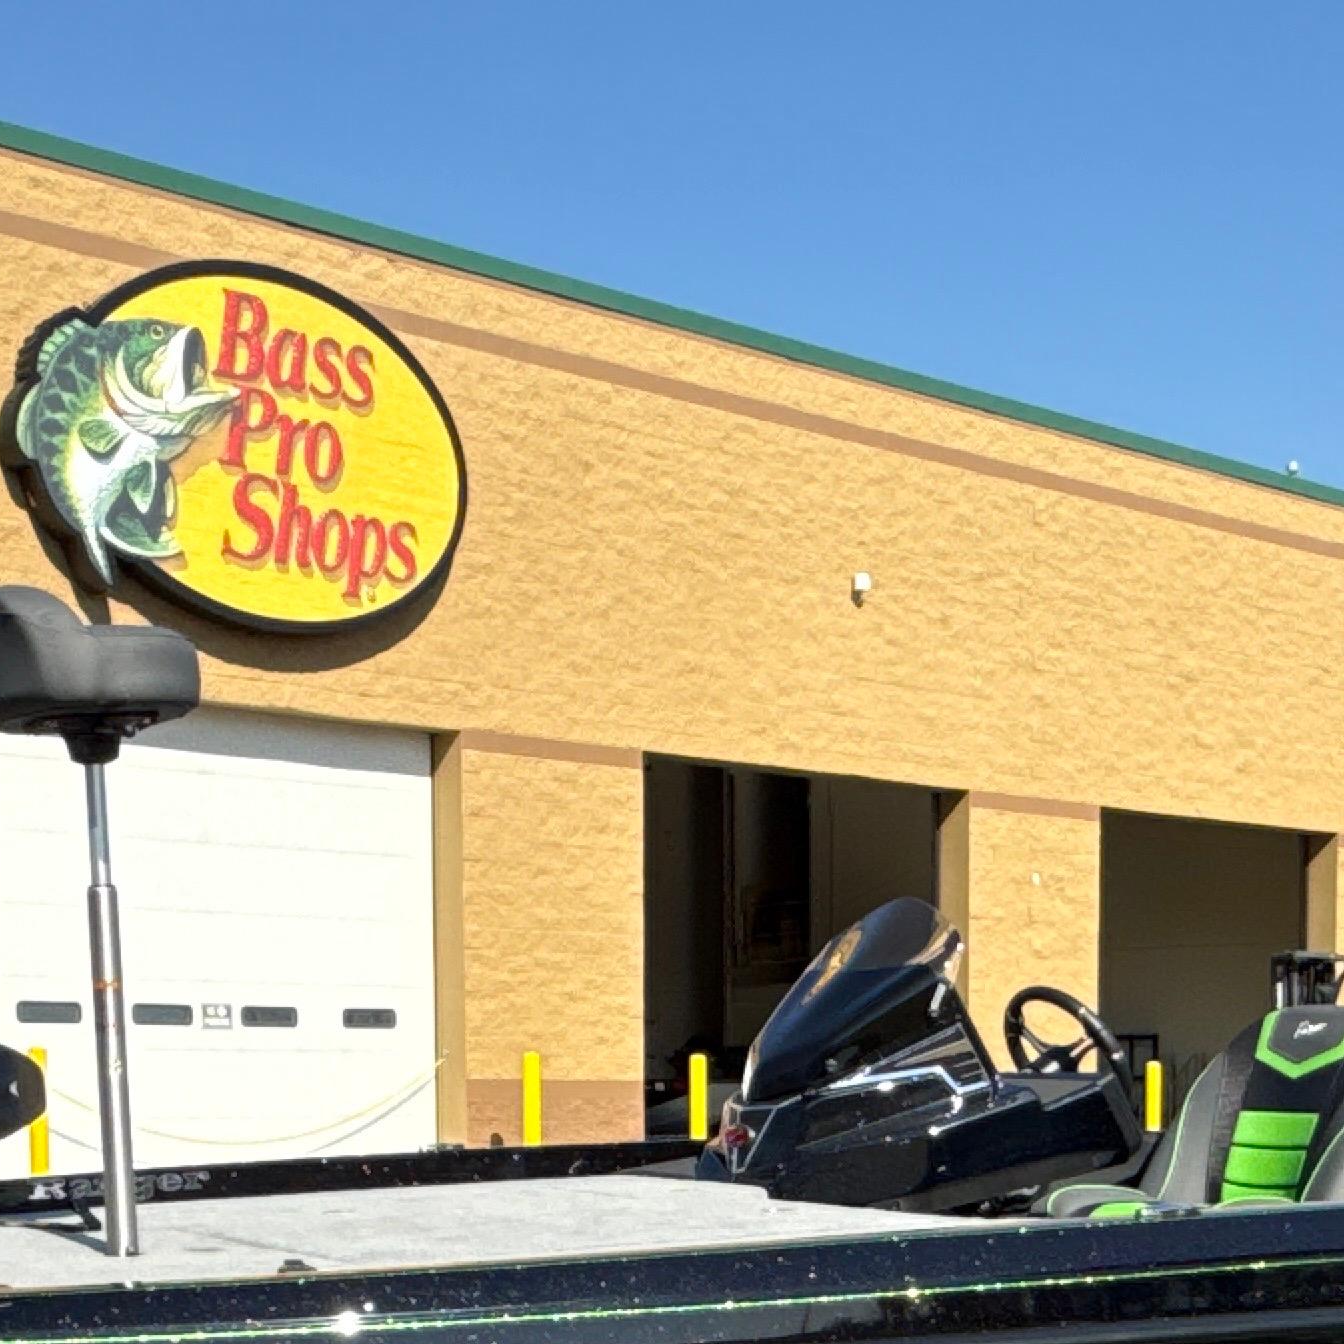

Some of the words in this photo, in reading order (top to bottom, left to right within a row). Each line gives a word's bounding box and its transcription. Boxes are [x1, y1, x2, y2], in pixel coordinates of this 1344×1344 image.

[213, 287, 377, 412] Bass
[218, 387, 344, 485] Pro
[221, 473, 418, 601] Shops
